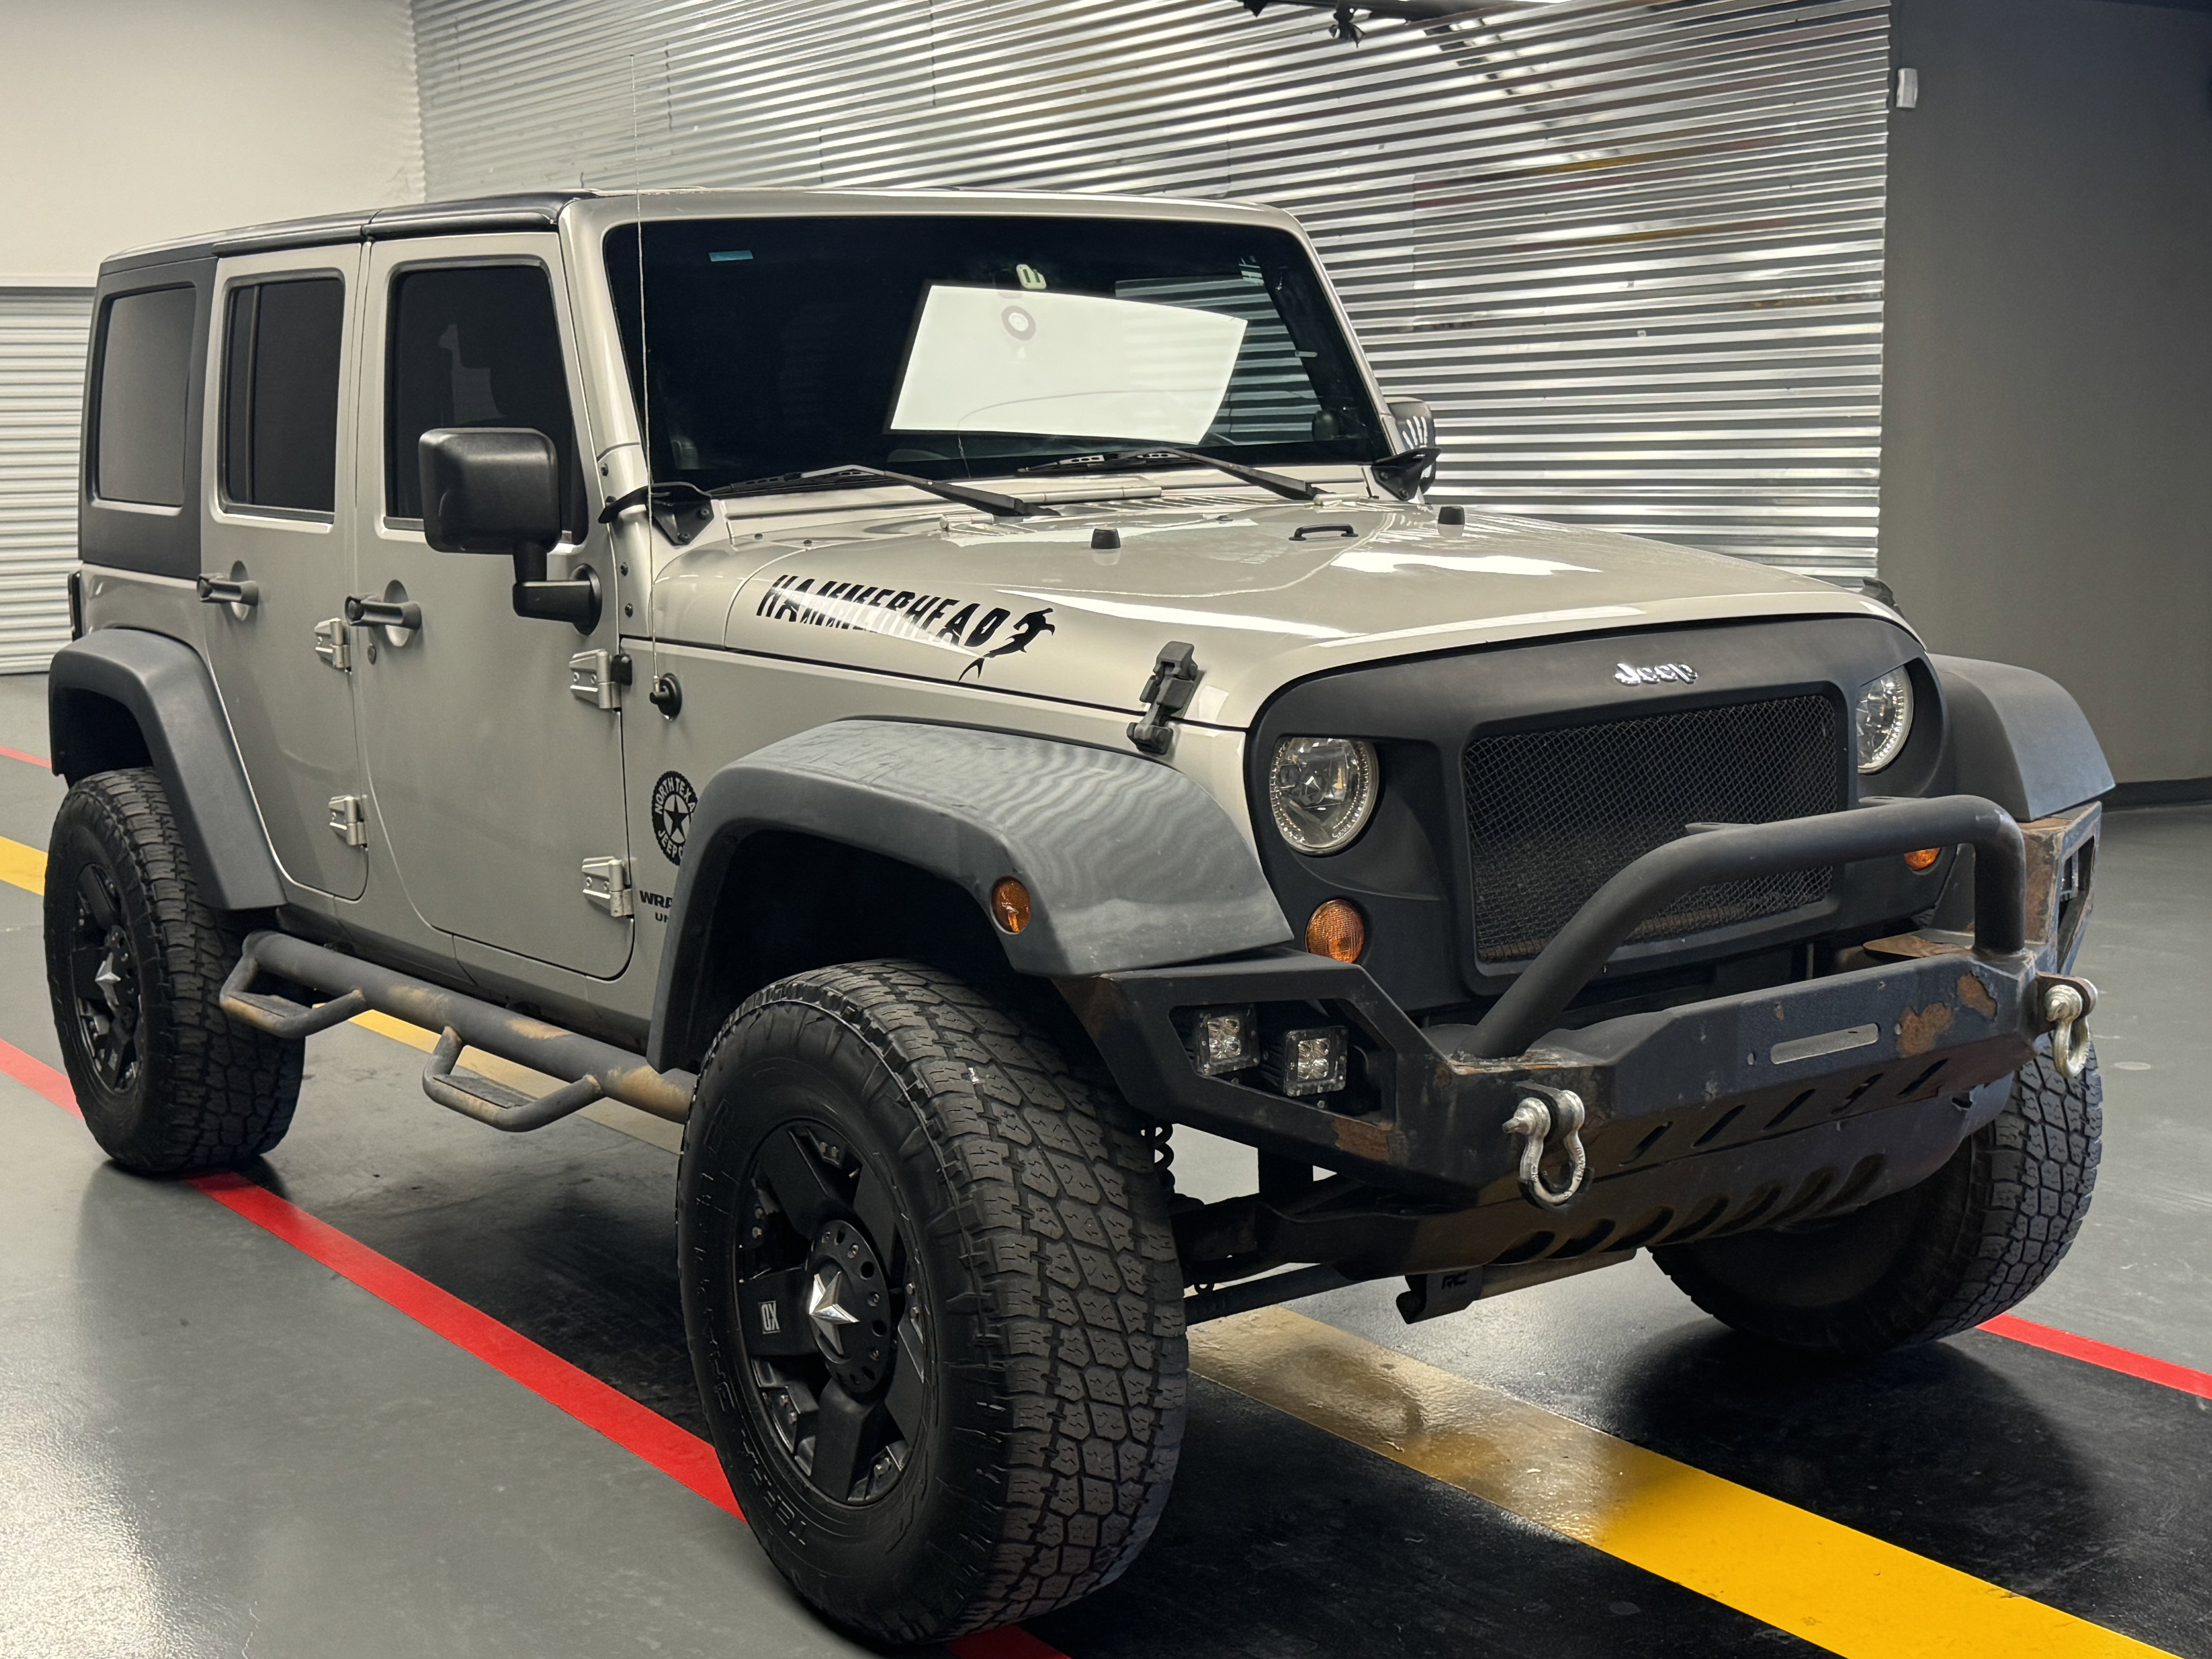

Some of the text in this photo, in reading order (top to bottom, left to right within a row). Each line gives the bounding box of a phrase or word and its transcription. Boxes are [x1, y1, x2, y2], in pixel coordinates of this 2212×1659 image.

[756, 575, 1010, 647] HAMMERHEAD
[1614, 663, 1697, 686] Jeep
[655, 777, 696, 815] NORTH TEXA
